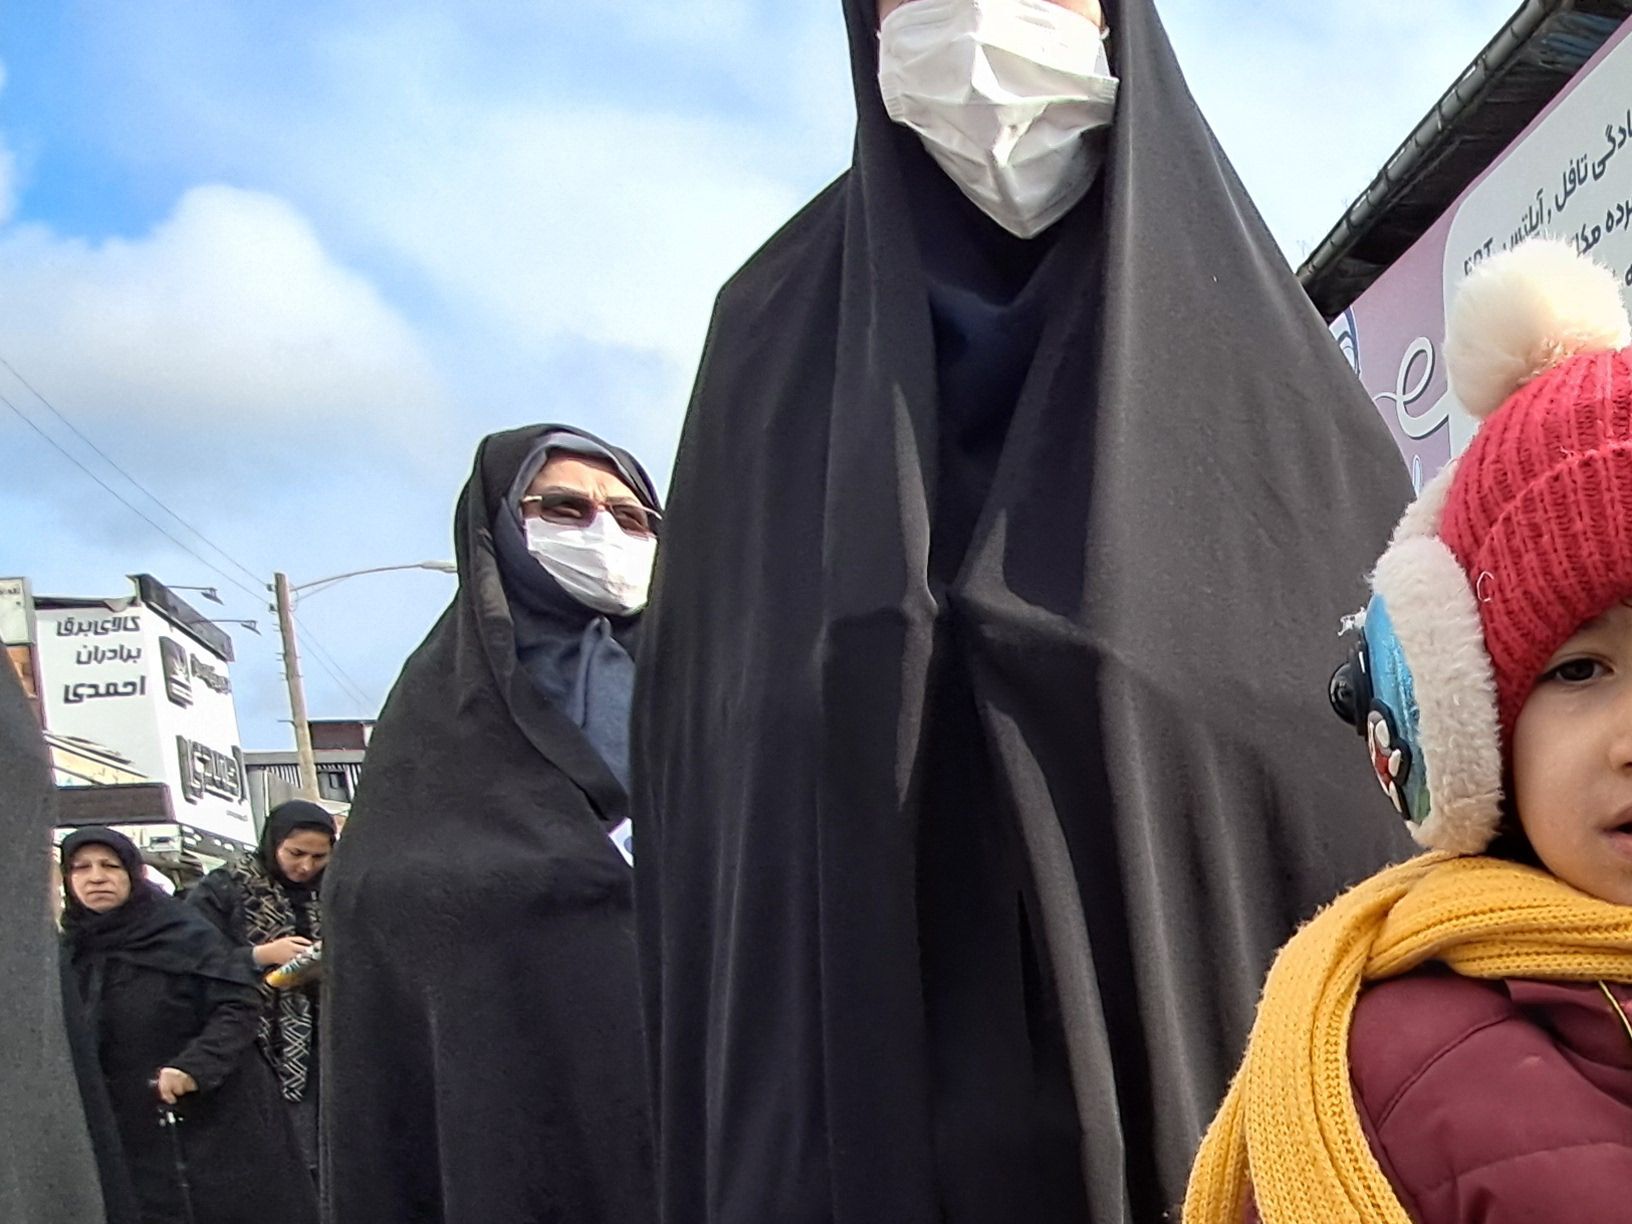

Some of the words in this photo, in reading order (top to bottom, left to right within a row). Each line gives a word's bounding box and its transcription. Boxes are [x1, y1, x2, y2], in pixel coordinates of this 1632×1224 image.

[1555, 153, 1588, 212] تافل
[56, 616, 94, 637] برق
[94, 615, 141, 636] کالای
[75, 643, 143, 666] برادران
[63, 674, 147, 705] احمدی
